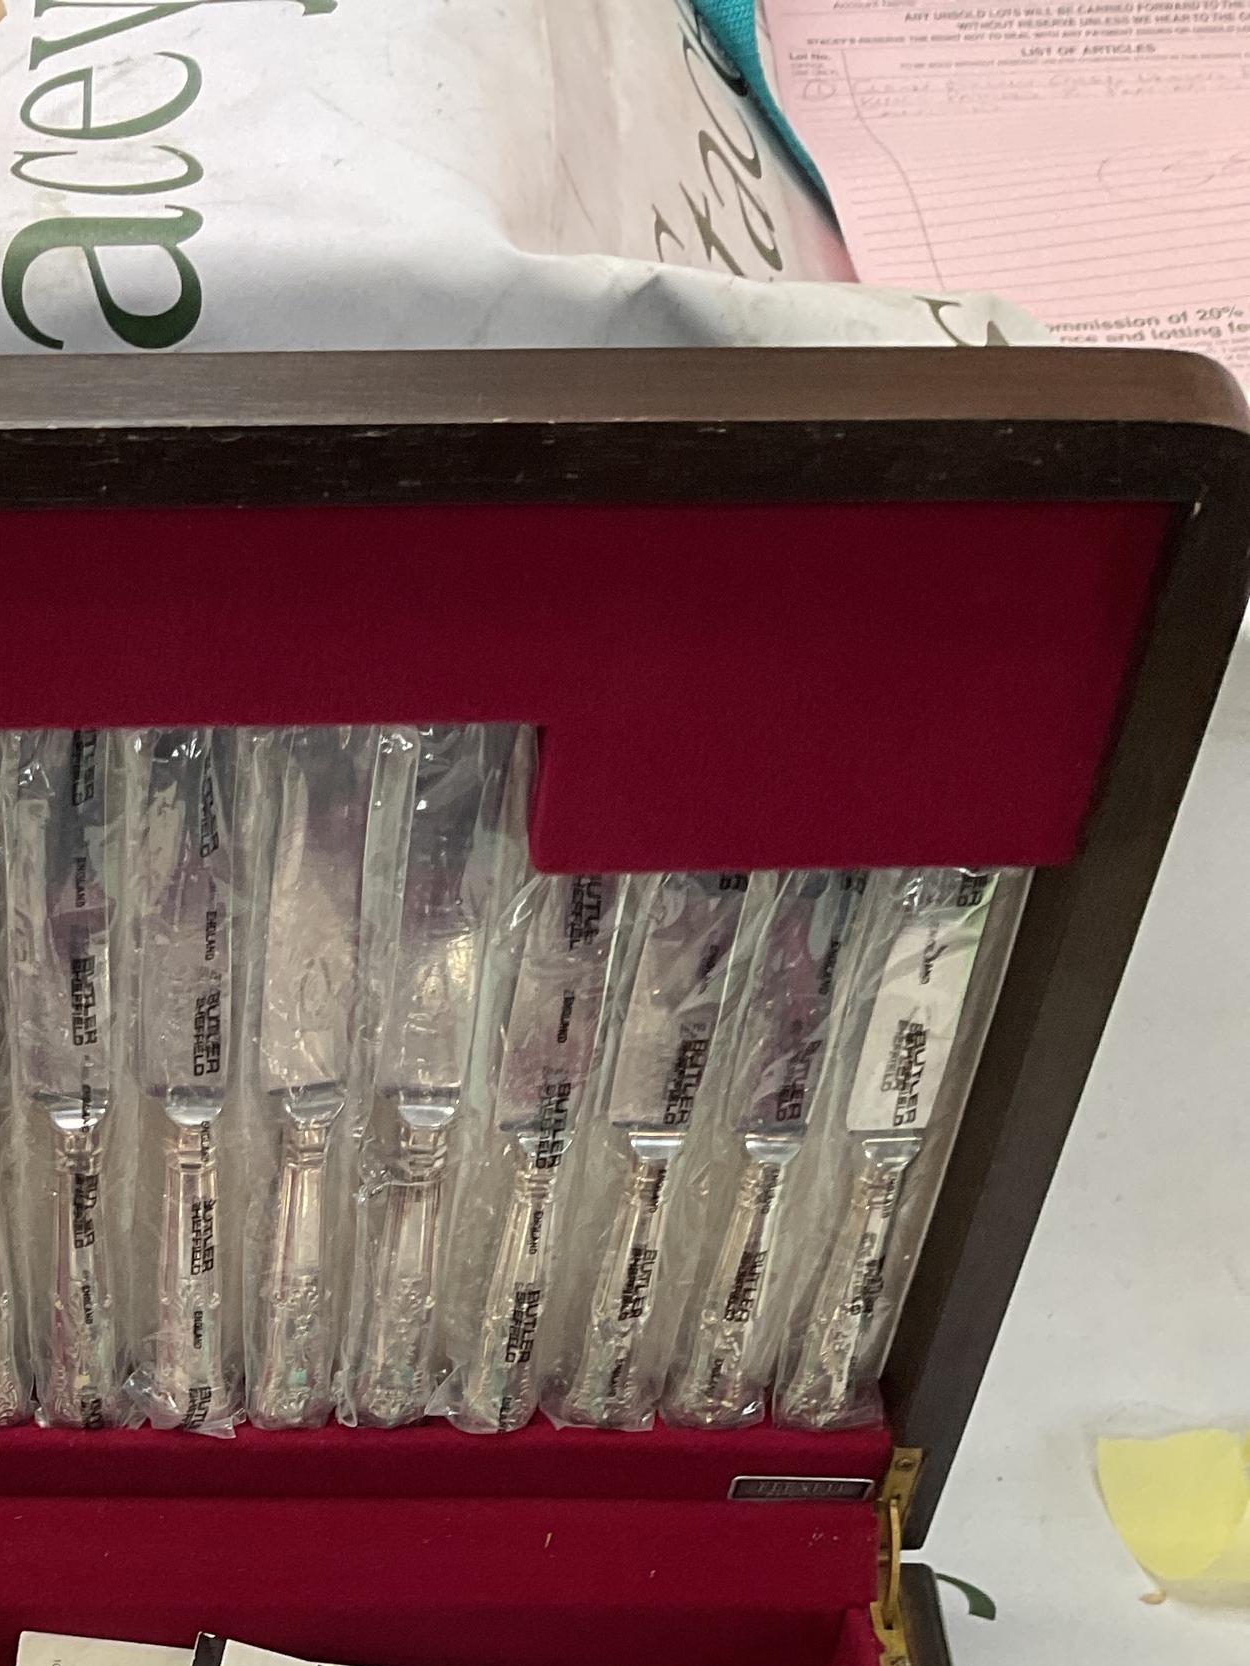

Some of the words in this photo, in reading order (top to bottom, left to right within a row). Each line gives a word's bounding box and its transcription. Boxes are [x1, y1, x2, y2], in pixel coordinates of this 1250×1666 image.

[1167, 310, 1188, 324] of
[1196, 304, 1244, 321] 20%
[1106, 329, 1145, 342] and
[517, 1290, 541, 1363] BUTLER
